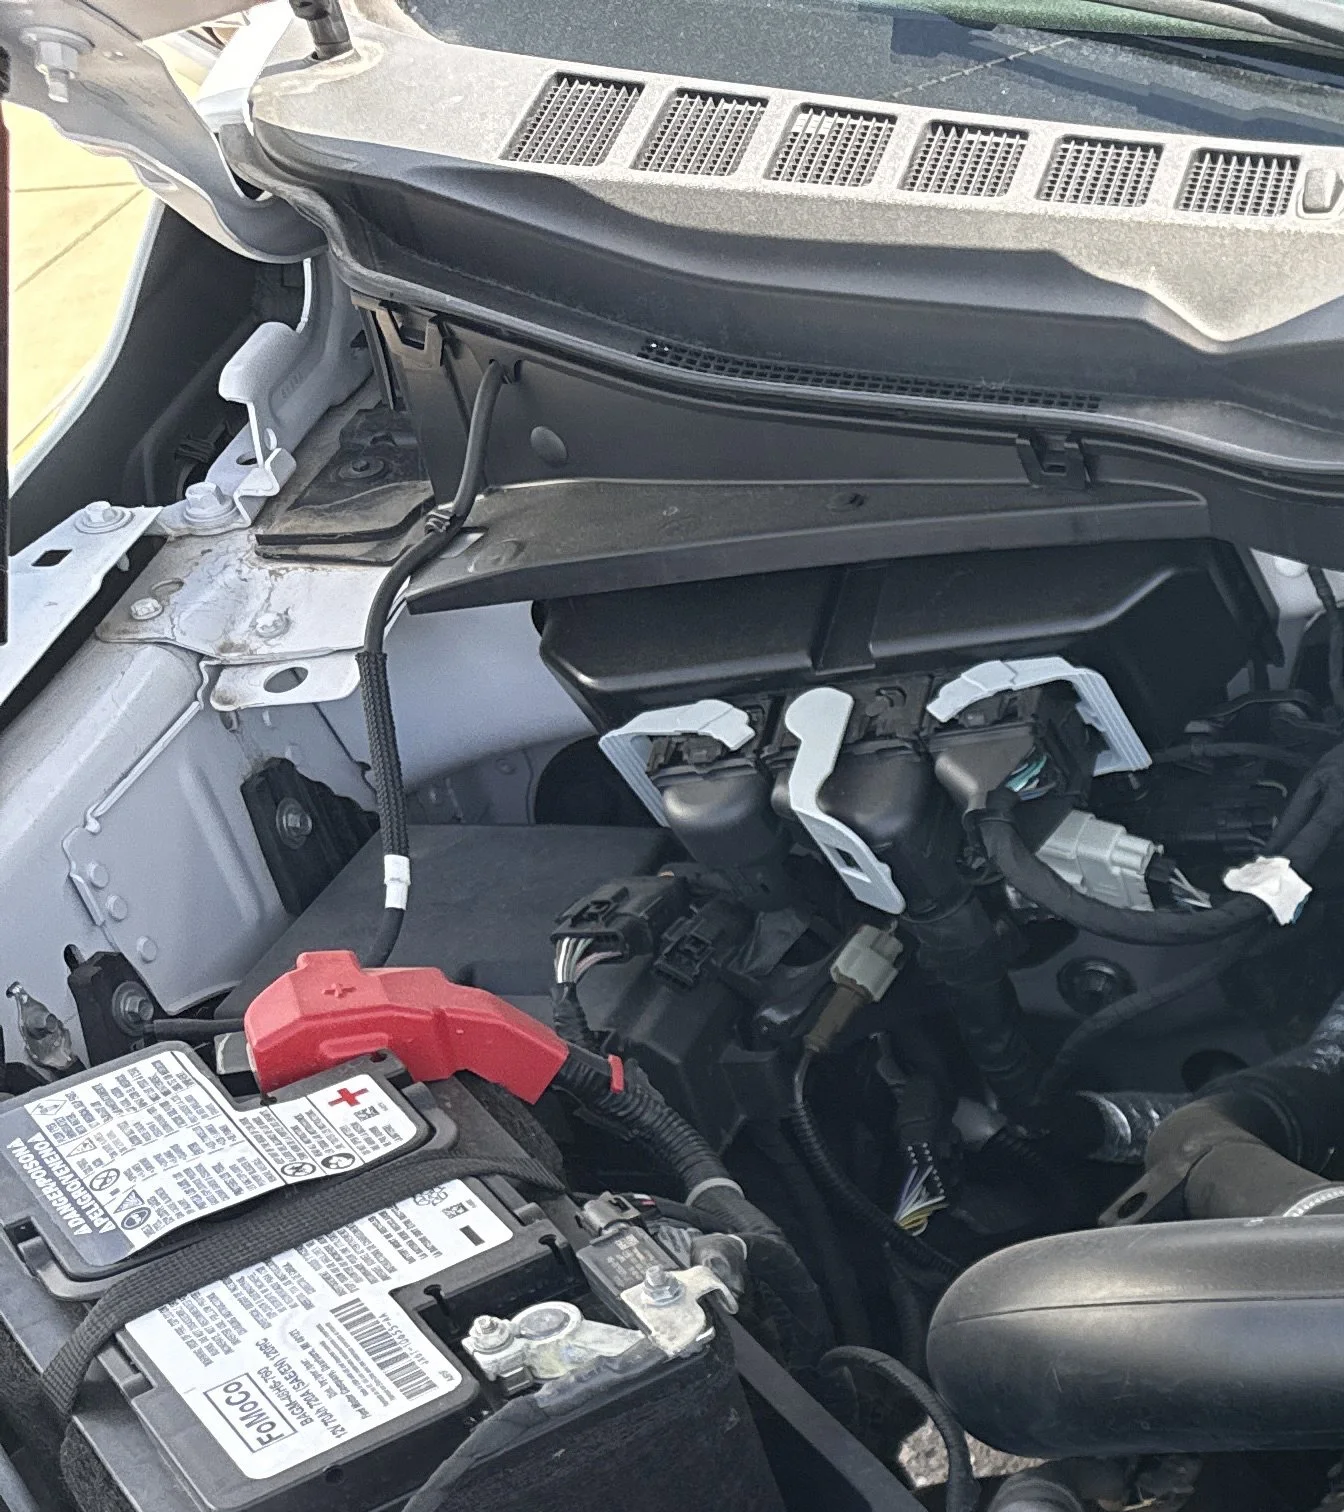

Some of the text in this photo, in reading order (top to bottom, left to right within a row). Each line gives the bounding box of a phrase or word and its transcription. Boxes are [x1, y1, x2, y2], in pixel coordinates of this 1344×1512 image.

[299, 1389, 322, 1409] 720A
[221, 1379, 284, 1445] FoMoCo
[327, 1423, 347, 1438] 12V
